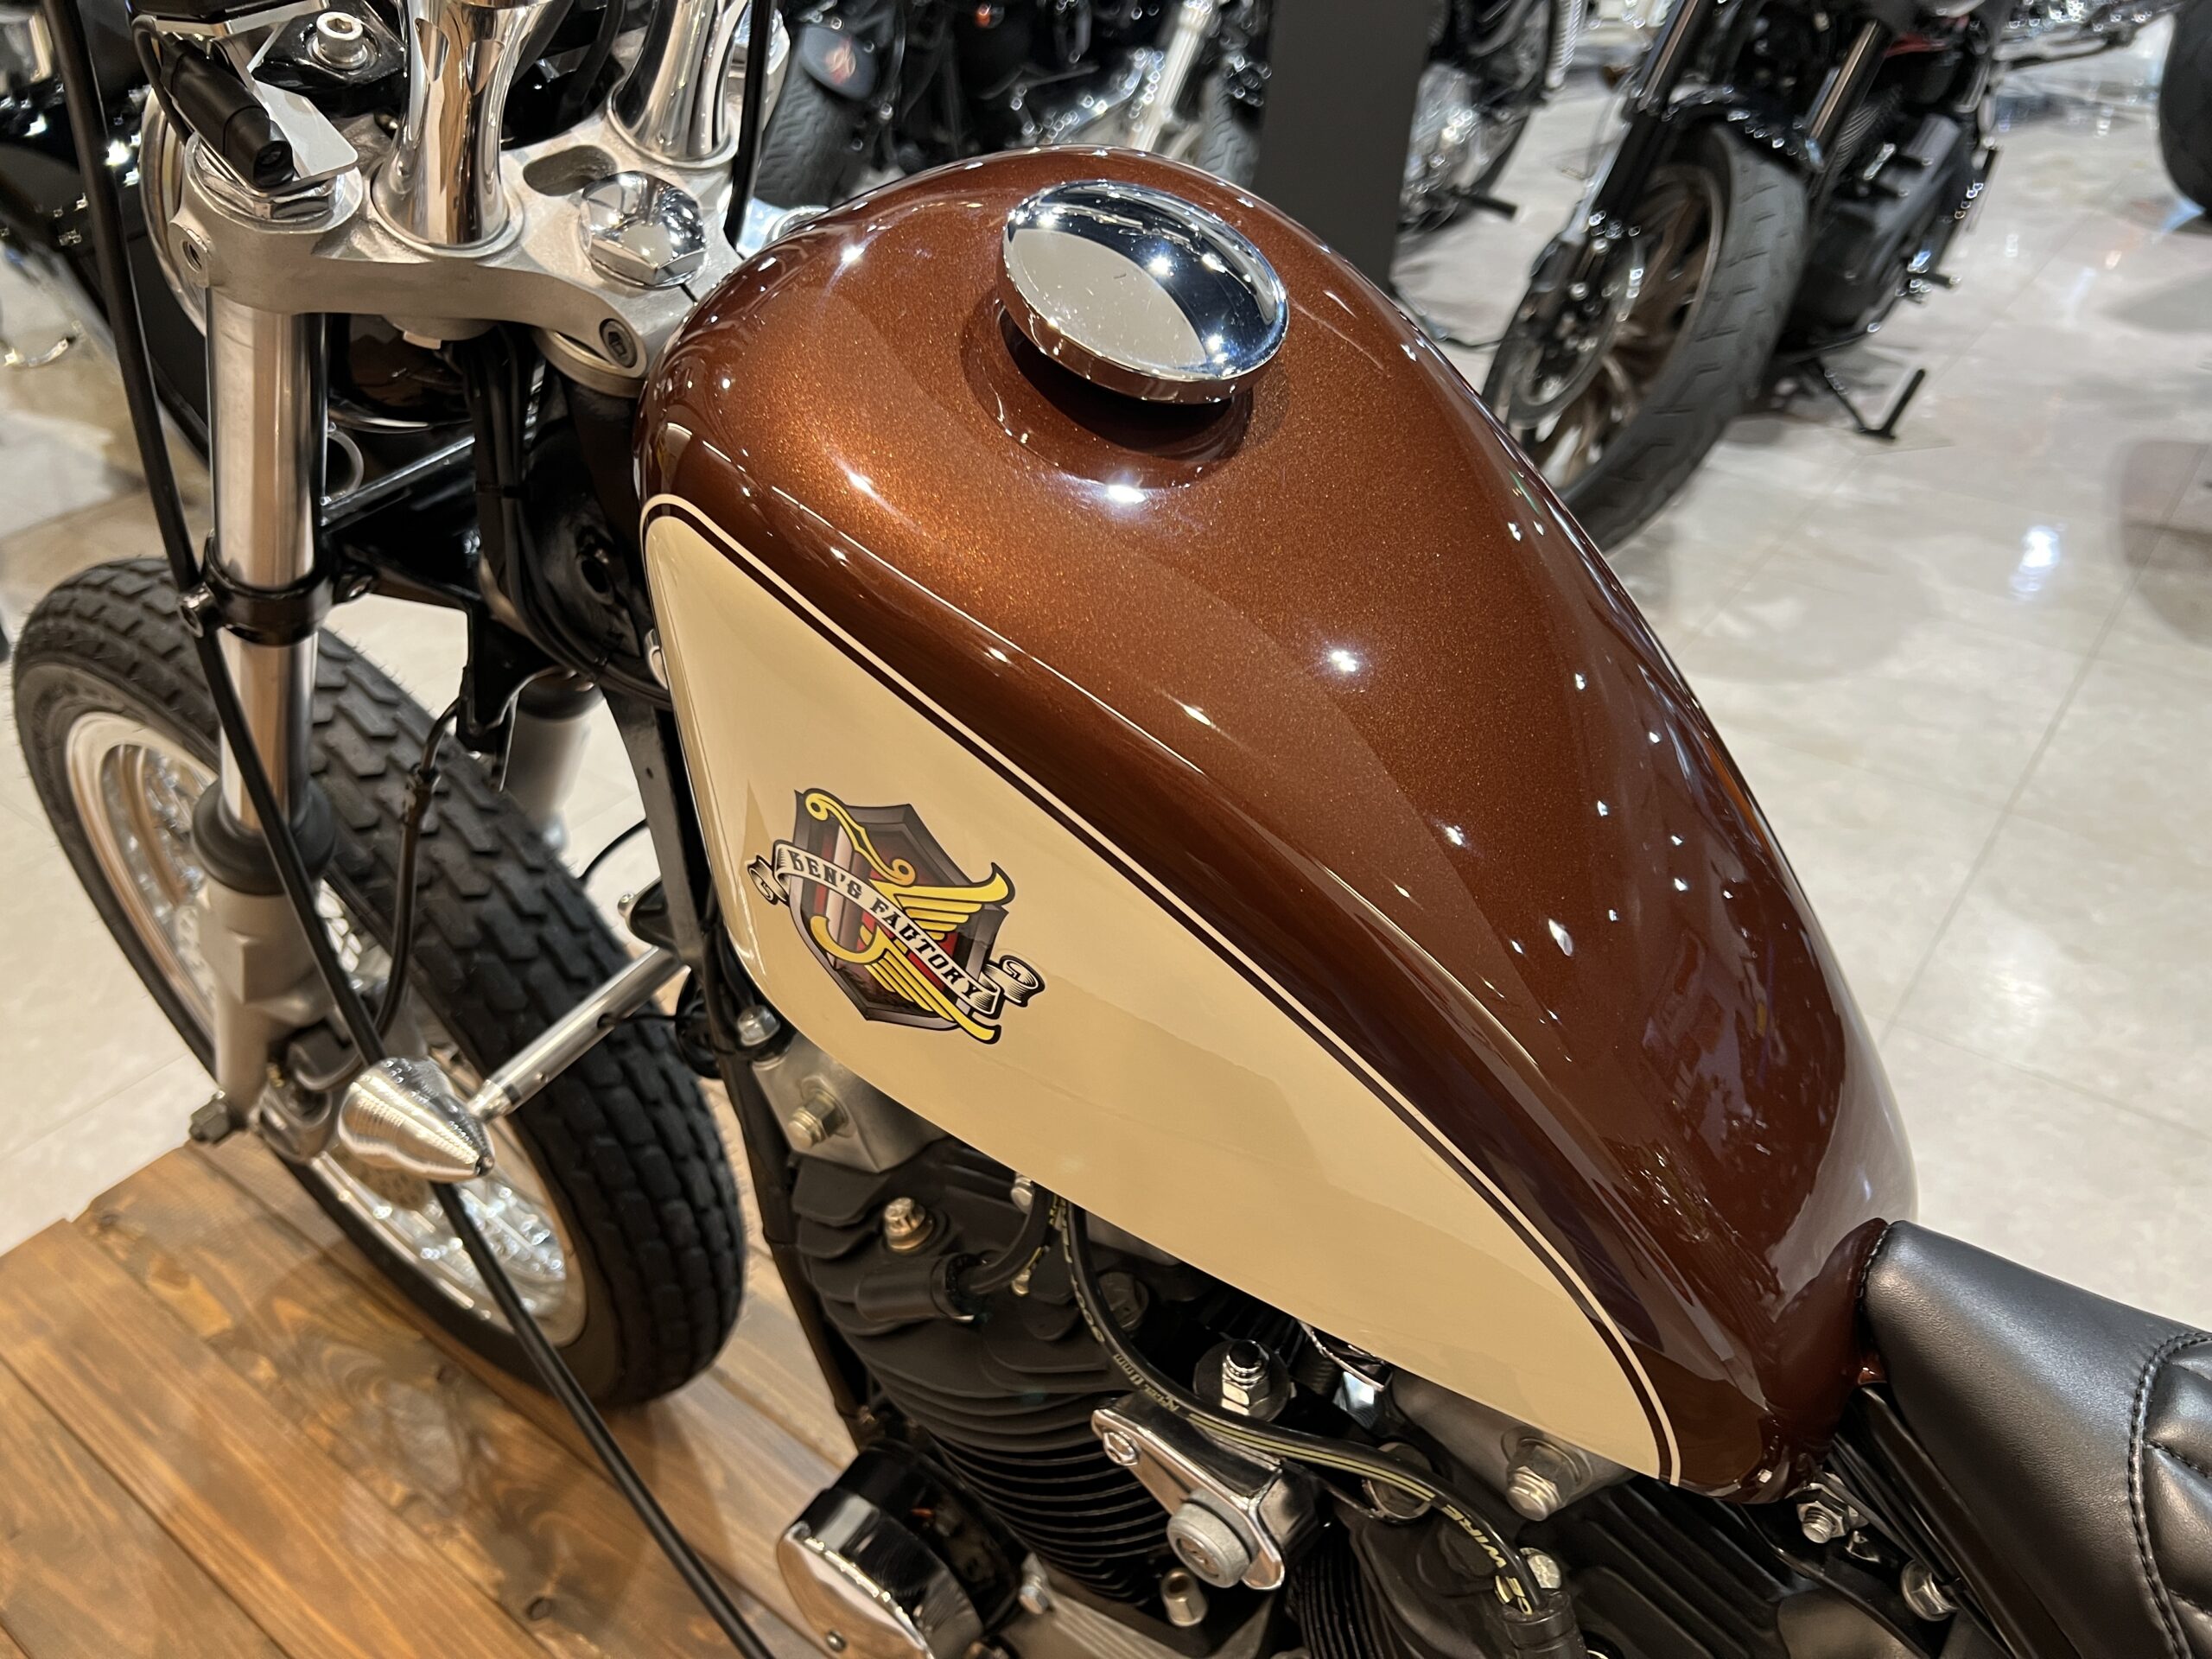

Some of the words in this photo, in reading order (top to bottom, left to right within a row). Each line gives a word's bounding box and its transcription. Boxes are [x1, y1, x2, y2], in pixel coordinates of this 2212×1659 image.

[789, 849, 862, 899] KEN'S
[870, 898, 983, 1000] FACTORY
[1441, 1504, 1507, 1568] WIRE
